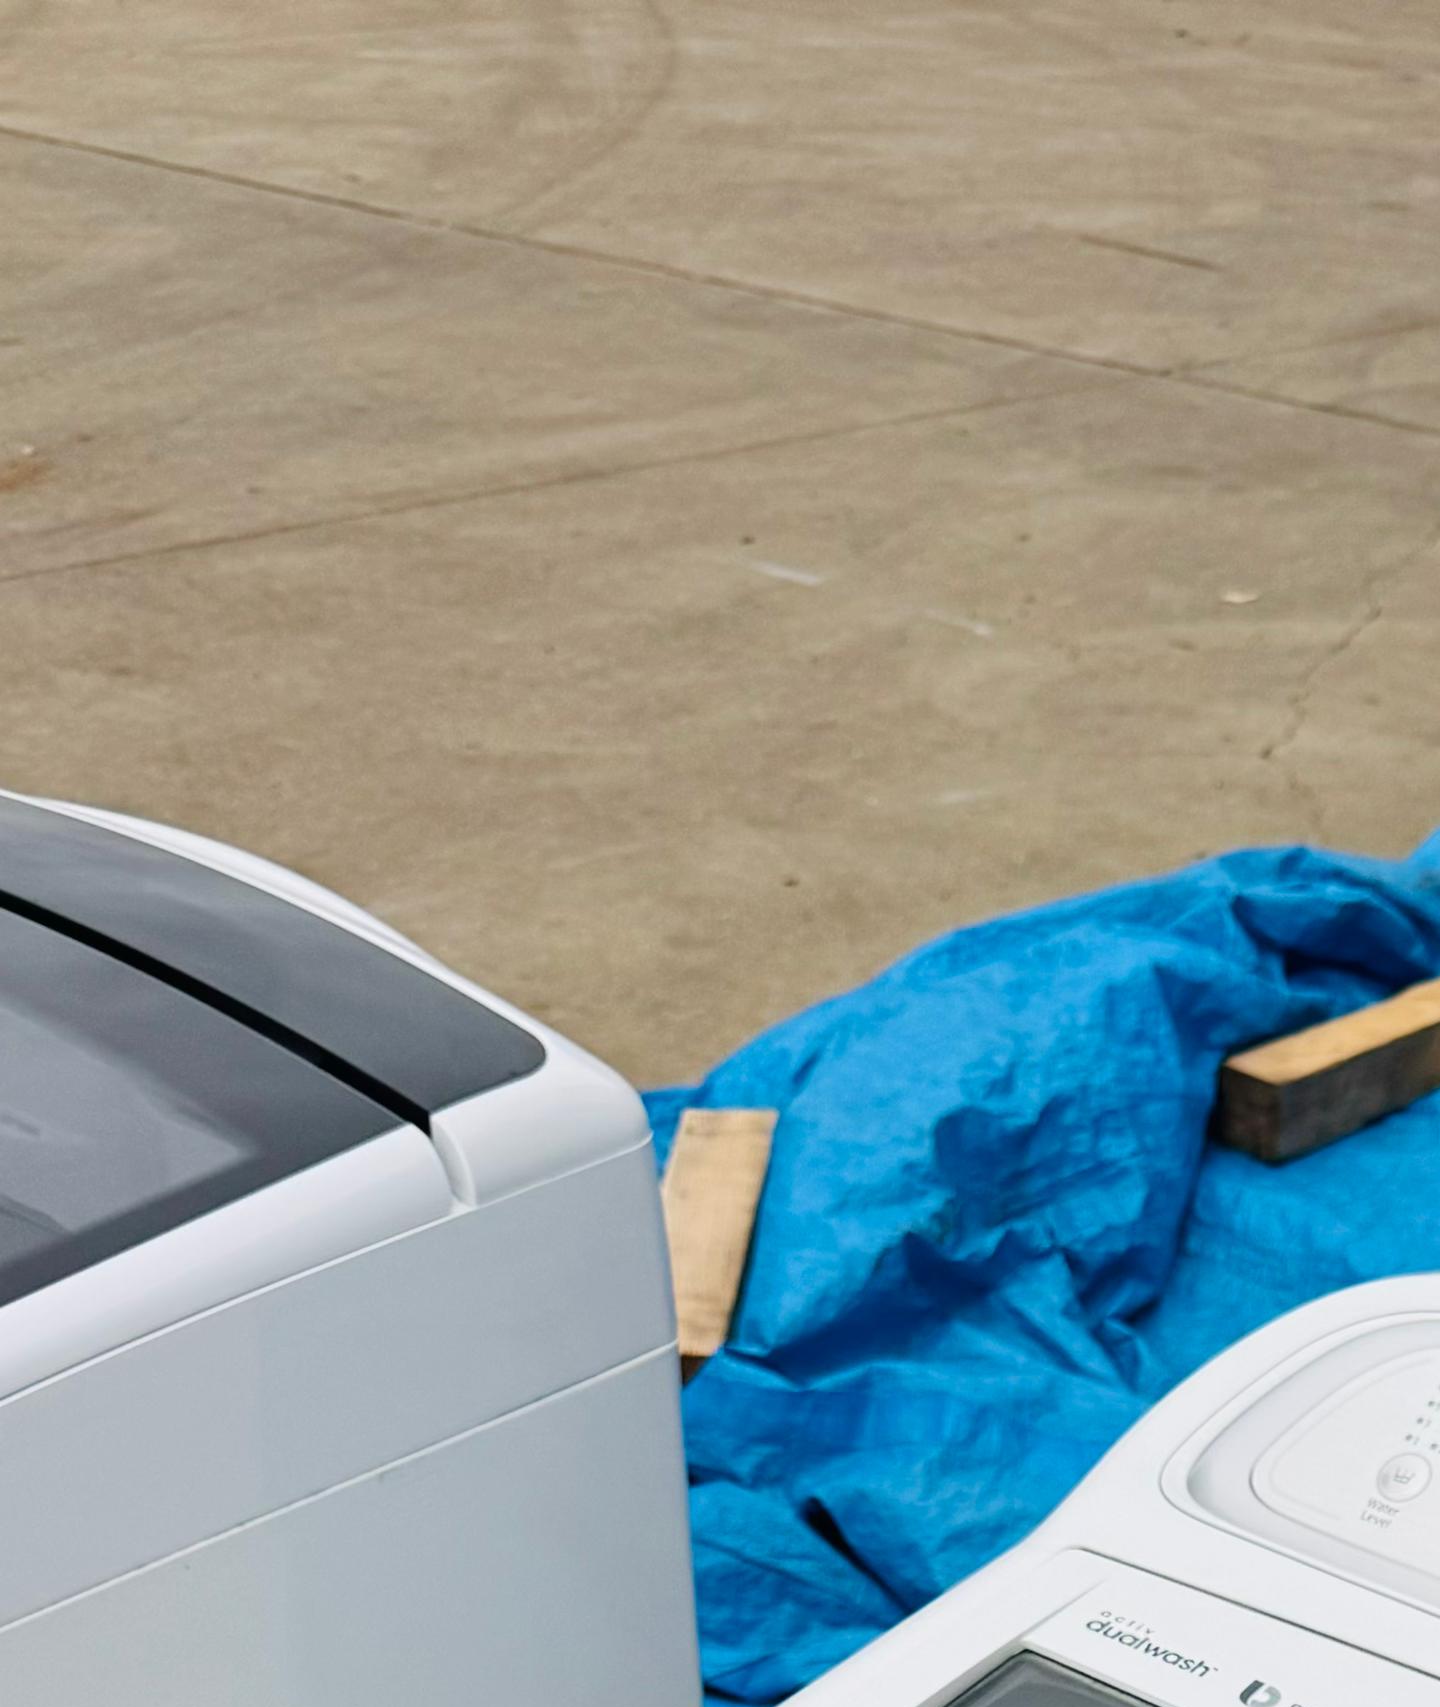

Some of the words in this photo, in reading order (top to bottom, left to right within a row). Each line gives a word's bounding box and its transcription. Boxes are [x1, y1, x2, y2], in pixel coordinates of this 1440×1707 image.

[1367, 1498, 1400, 1517] Water
[1360, 1510, 1393, 1529] Level
[1100, 1610, 1155, 1634] activ
[1086, 1620, 1211, 1677] dualwash
